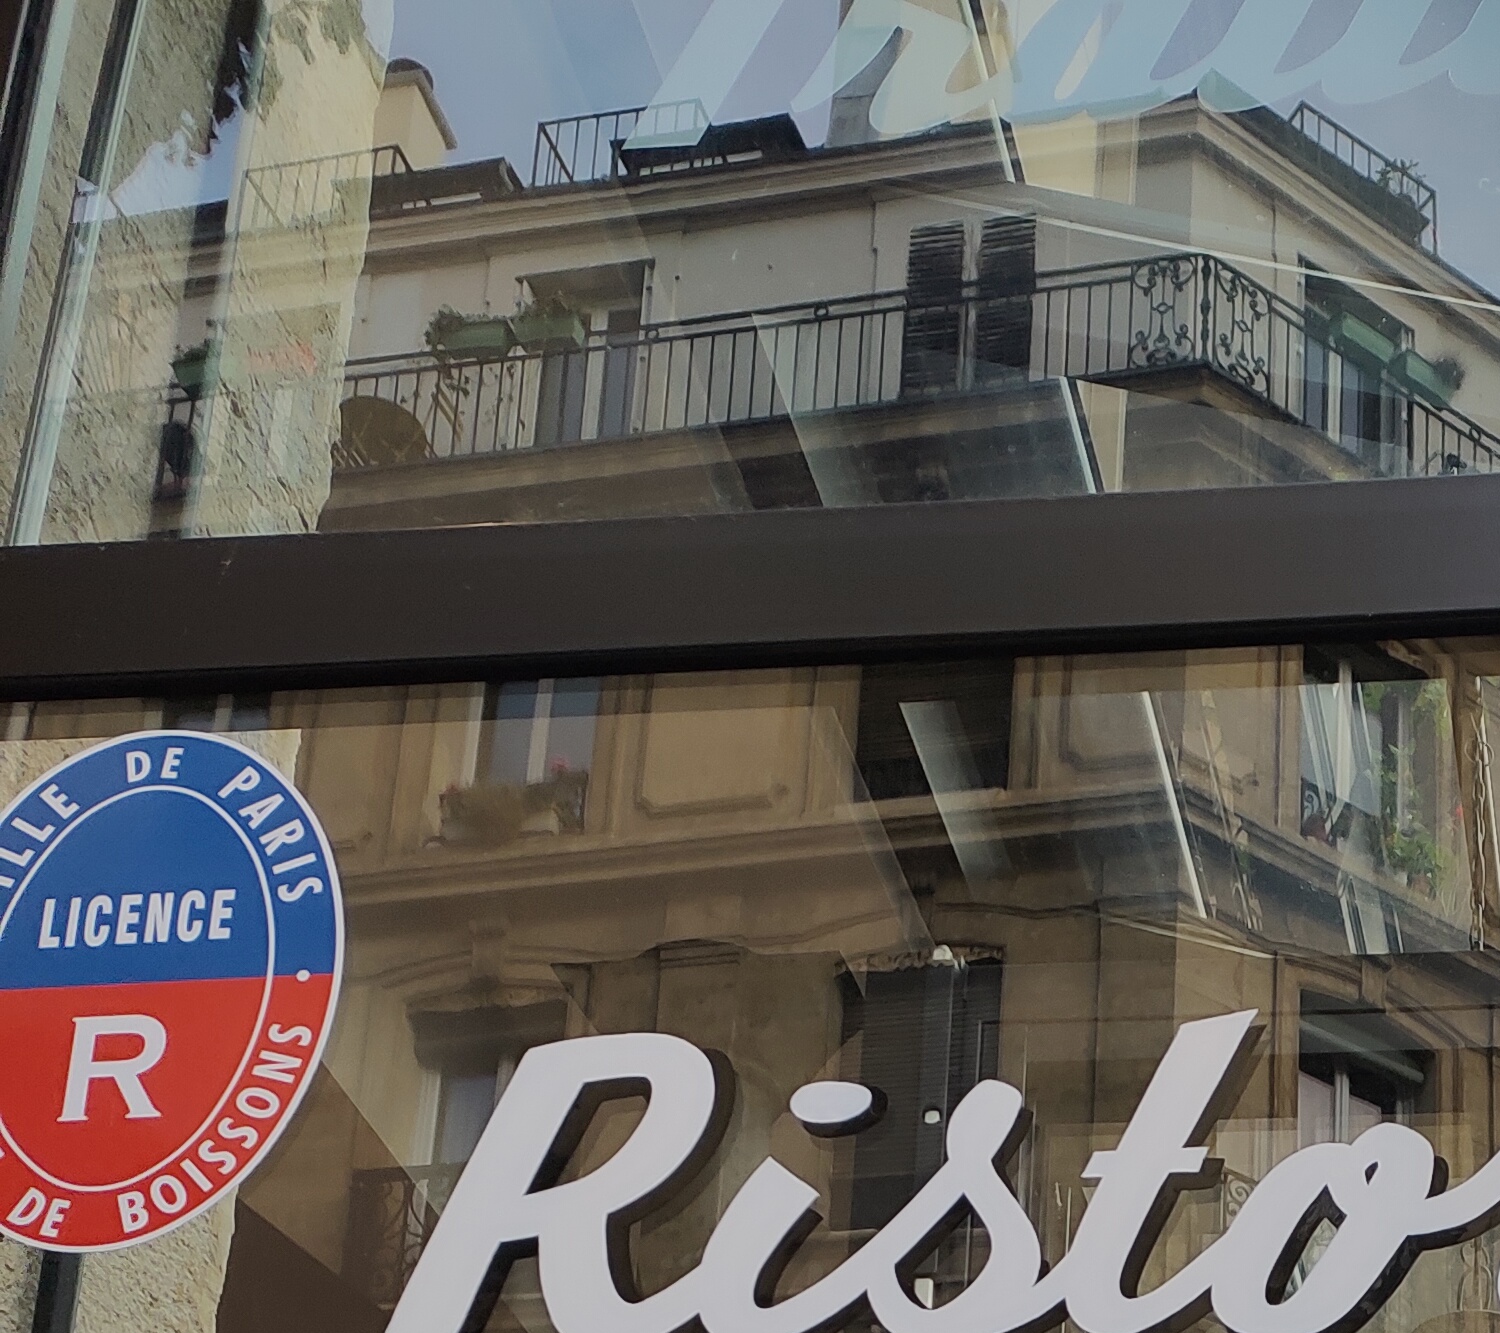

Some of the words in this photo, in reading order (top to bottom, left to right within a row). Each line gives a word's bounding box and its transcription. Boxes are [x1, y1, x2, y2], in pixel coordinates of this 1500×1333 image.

[0, 783, 78, 890] ILLE
[126, 747, 184, 782] DE
[218, 765, 324, 903] PARIS
[37, 888, 237, 949] LICENCE
[7, 1186, 72, 1239] DE
[117, 1022, 313, 1234] BOISSONS
[56, 1013, 168, 1122] R
